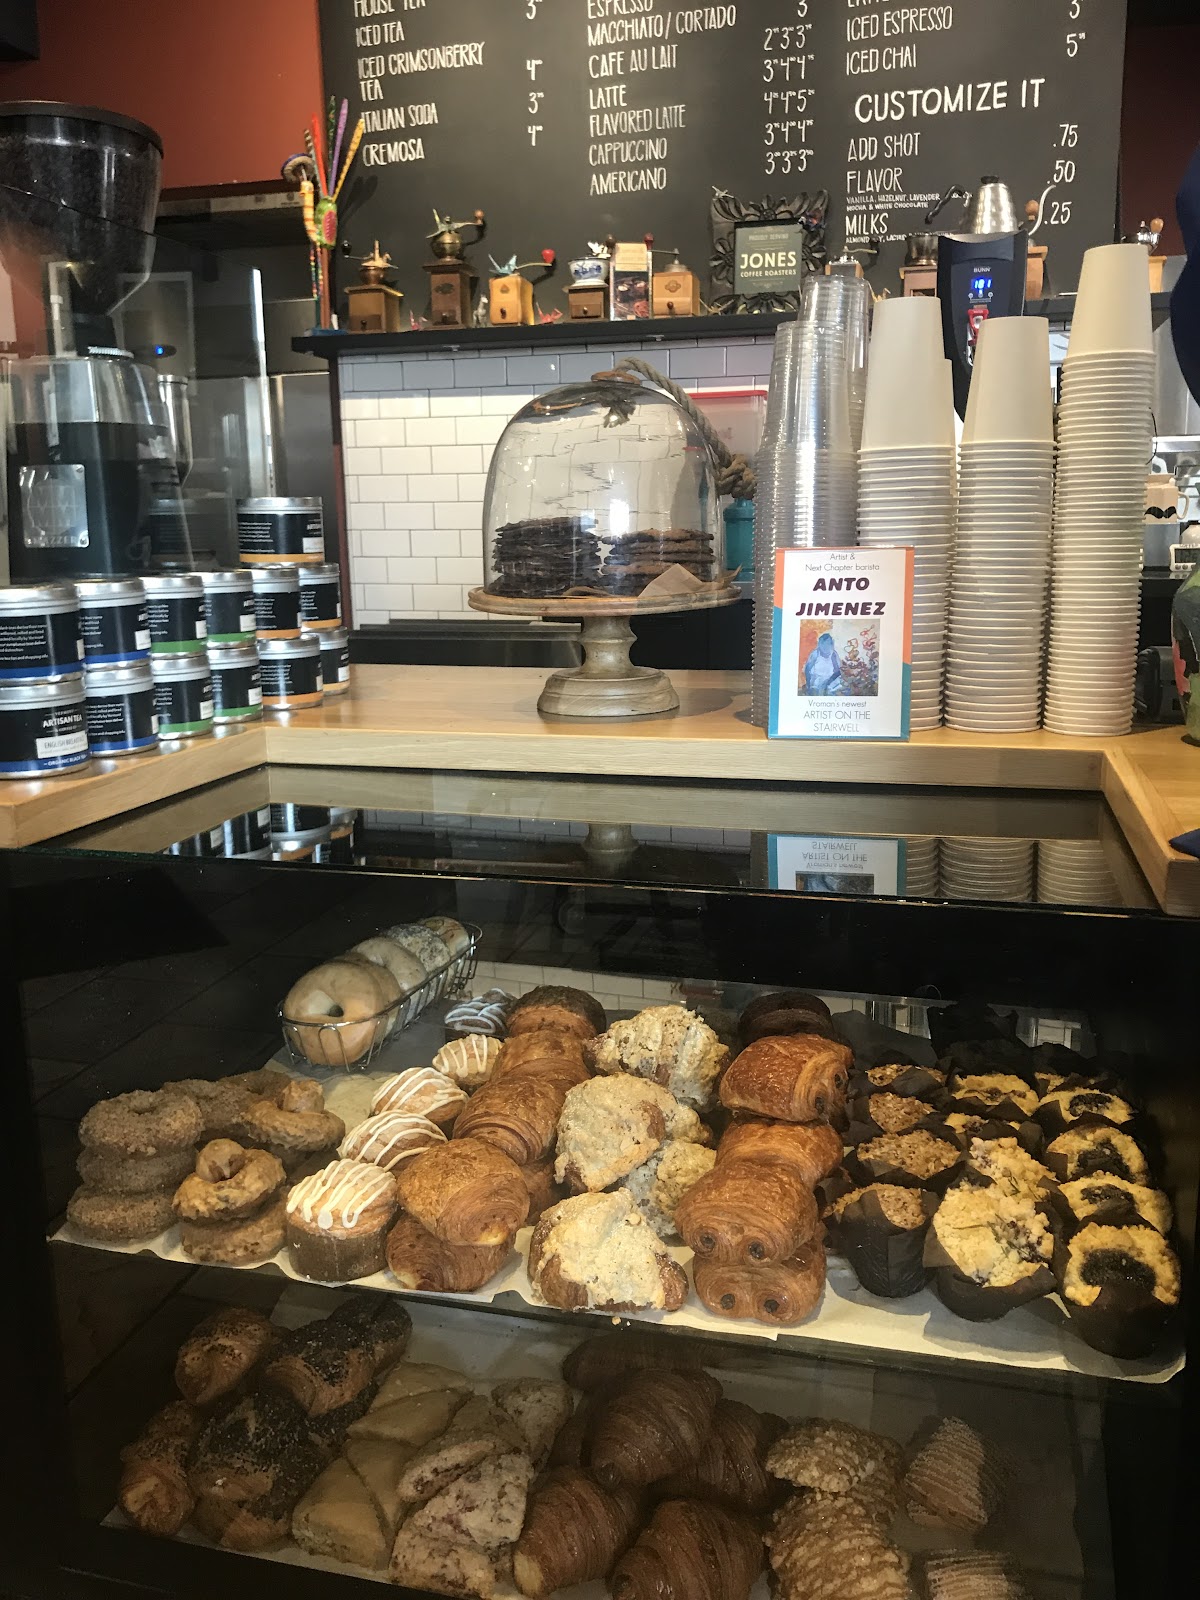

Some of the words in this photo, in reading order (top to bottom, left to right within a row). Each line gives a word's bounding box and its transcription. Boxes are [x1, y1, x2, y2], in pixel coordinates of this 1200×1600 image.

[676, 5, 736, 34] CORTADO
[847, 14, 879, 42] ICED
[884, 6, 952, 36] ESPRESSO
[356, 24, 380, 47] ICED
[382, 21, 405, 44] TEA
[358, 55, 385, 80] ICED
[388, 41, 485, 76] CRIMSONBERRY
[588, 51, 624, 78] CAFE
[630, 48, 647, 72] AU
[652, 44, 678, 70] LAIT
[846, 48, 879, 75] ICED
[882, 44, 916, 70] CHAI
[360, 79, 383, 102] TEA
[589, 85, 627, 109] LATTE
[854, 81, 1008, 123] CUSTOMIZE
[1021, 78, 1045, 108] IT
[361, 107, 405, 133] ITALIAN
[408, 102, 438, 127] SODA
[590, 108, 653, 137] FLAVORED
[656, 104, 686, 130] LATTE
[848, 137, 878, 162] ADD
[884, 132, 920, 158] SHOT
[1053, 124, 1078, 148] .75
[362, 138, 425, 166] CREMOSA
[589, 138, 667, 166] CAPPUCCINO
[590, 167, 667, 196] AMERICANO
[847, 168, 903, 193] FLAVOR
[1047, 160, 1076, 184] .50
[845, 213, 888, 236] MILKS
[1044, 201, 1072, 224] .25
[740, 251, 797, 269] JONES
[824, 564, 853, 572] Chapter
[813, 577, 870, 591] ANTO
[796, 602, 886, 616] JIMENEZ
[43, 716, 72, 728] ARTISAN
[803, 711, 832, 719] ARTIST
[835, 711, 852, 719] ON
[855, 711, 870, 719] THE
[814, 723, 859, 732] STAIRWELL
[44, 740, 65, 749] ENGLISH
